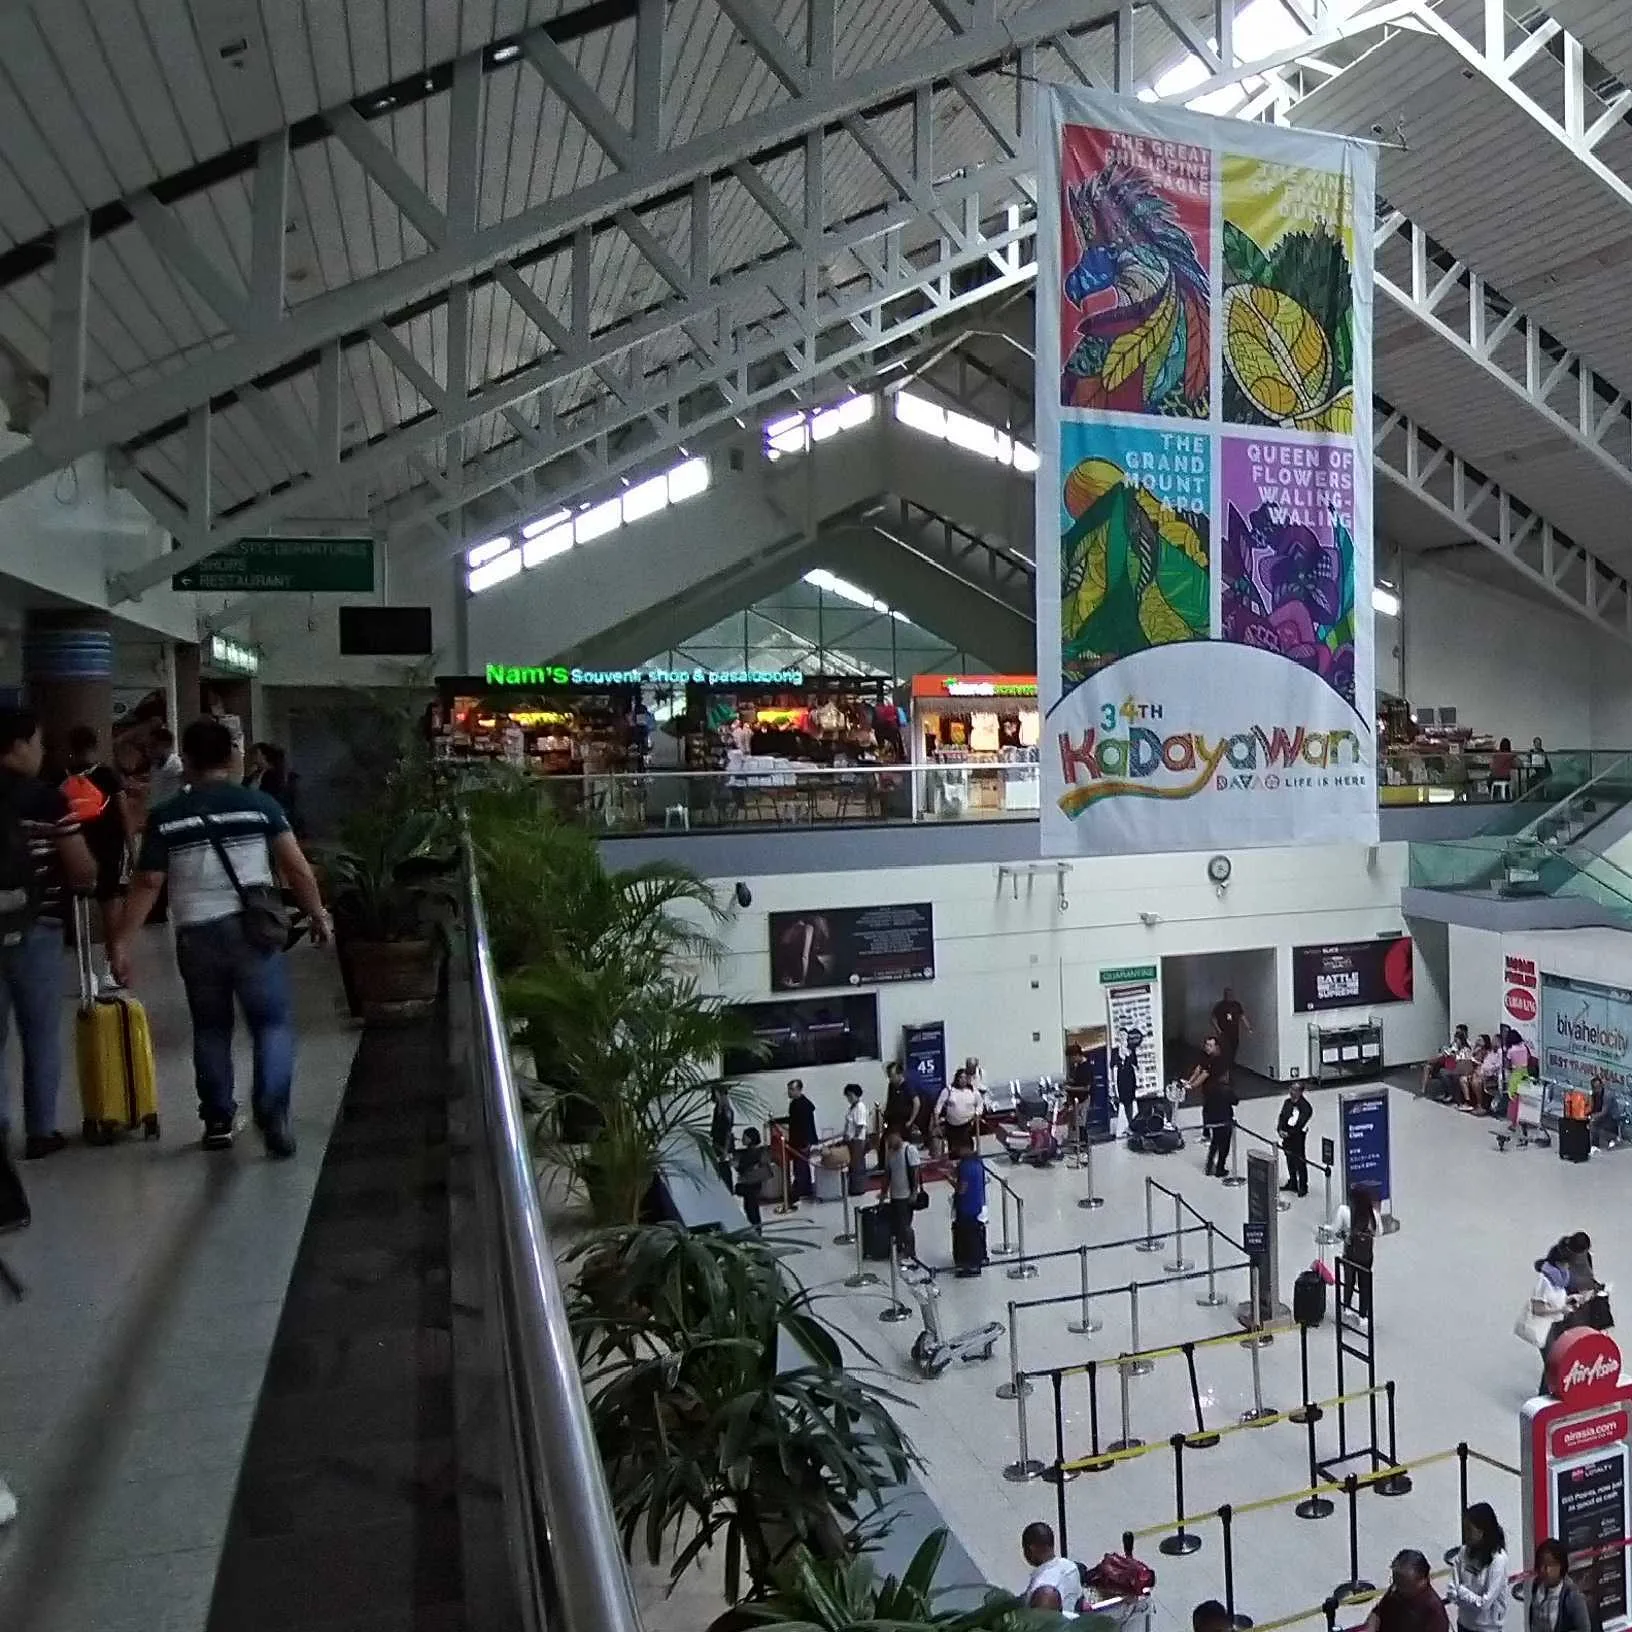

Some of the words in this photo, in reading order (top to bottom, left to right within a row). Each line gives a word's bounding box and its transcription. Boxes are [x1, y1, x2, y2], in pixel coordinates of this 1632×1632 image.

[1111, 132, 1145, 153] THE
[1151, 140, 1210, 163] GREAT
[1152, 173, 1210, 196] EAGLE
[1160, 433, 1205, 453] THE
[1125, 450, 1206, 475] GRAND
[1248, 444, 1320, 468] QUEEN
[1329, 450, 1354, 470] OF
[1124, 471, 1206, 494] MOUNT
[1252, 465, 1353, 490] FLOWERS
[1161, 494, 1205, 514] APO
[1258, 485, 1353, 508] WALING-
[1268, 505, 1353, 528] WALING
[485, 664, 570, 686] Nam's
[648, 669, 689, 685] shop
[693, 670, 706, 683] &
[1284, 778, 1313, 788] LIFE
[1317, 777, 1329, 788] IS
[1334, 775, 1367, 787] HERE
[917, 1059, 935, 1074] 45
[1563, 1352, 1620, 1393] AirAsia
[1563, 1420, 1618, 1444] airasia.com
